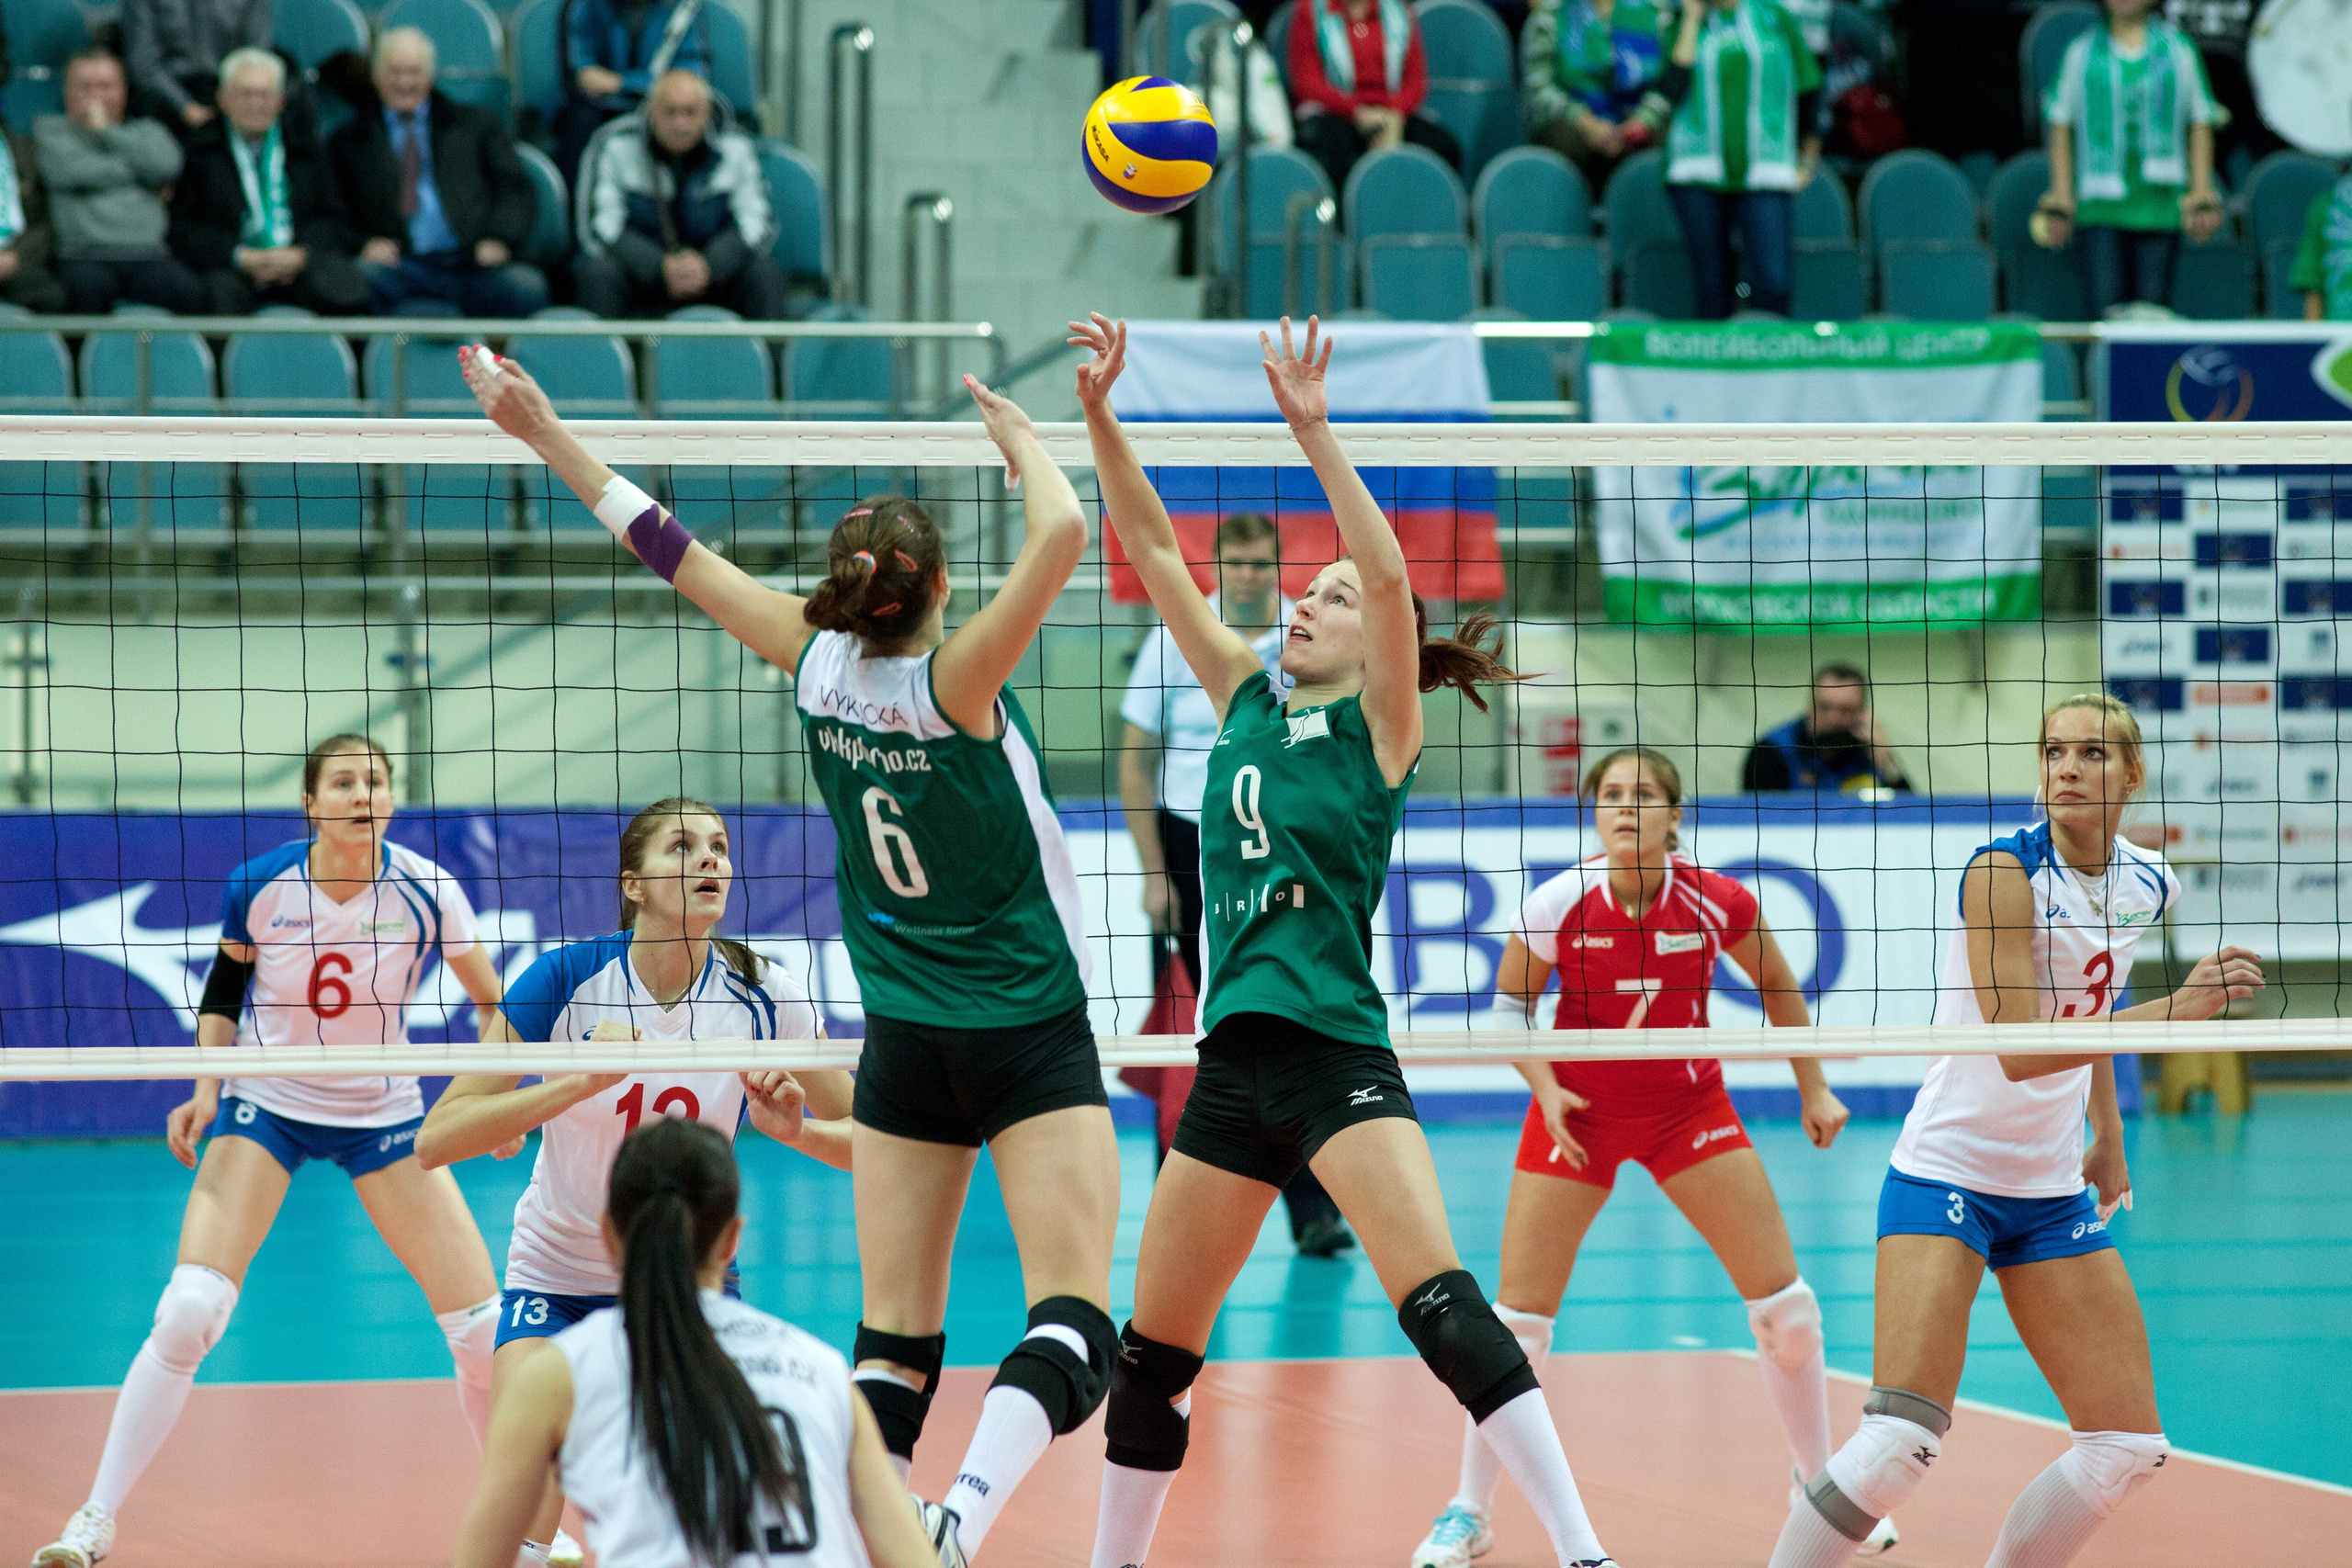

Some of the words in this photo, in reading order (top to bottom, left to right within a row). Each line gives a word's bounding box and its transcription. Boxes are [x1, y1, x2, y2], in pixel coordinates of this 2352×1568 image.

[862, 785, 929, 898] 6
[1232, 765, 1270, 860] 9
[308, 952, 353, 1020] 6
[1615, 978, 1661, 1029] 7
[2061, 951, 2114, 1017] 3
[234, 1101, 258, 1125] 6
[1947, 1191, 1965, 1224] 3
[511, 1295, 550, 1327] 13
